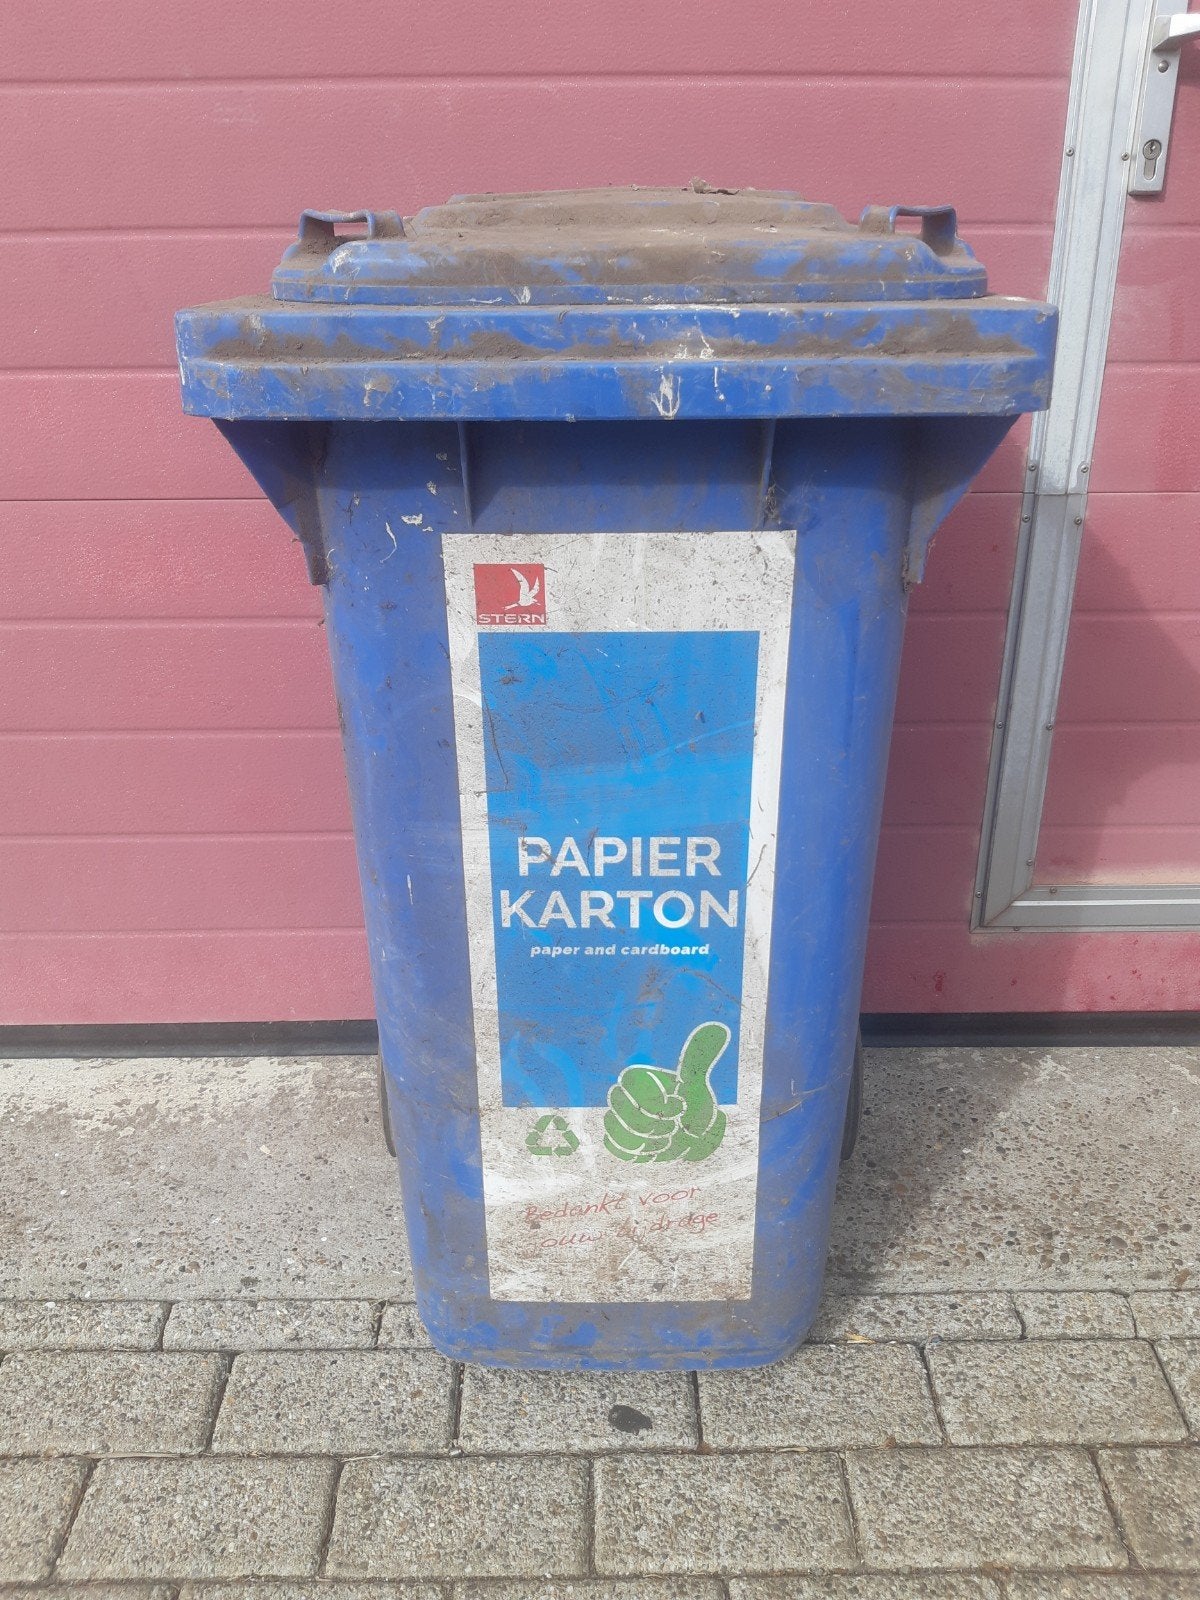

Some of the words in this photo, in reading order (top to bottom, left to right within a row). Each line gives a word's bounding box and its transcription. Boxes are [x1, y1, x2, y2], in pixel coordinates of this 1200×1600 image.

[478, 613, 546, 624] STERN
[517, 836, 722, 877] PAPIER
[499, 889, 739, 929] KARTON
[530, 945, 580, 958] paper
[584, 943, 616, 956] and
[620, 943, 710, 956] cardboard
[524, 1192, 626, 1224] Bedankt
[638, 1185, 702, 1207] voor
[528, 1231, 606, 1254] ouw
